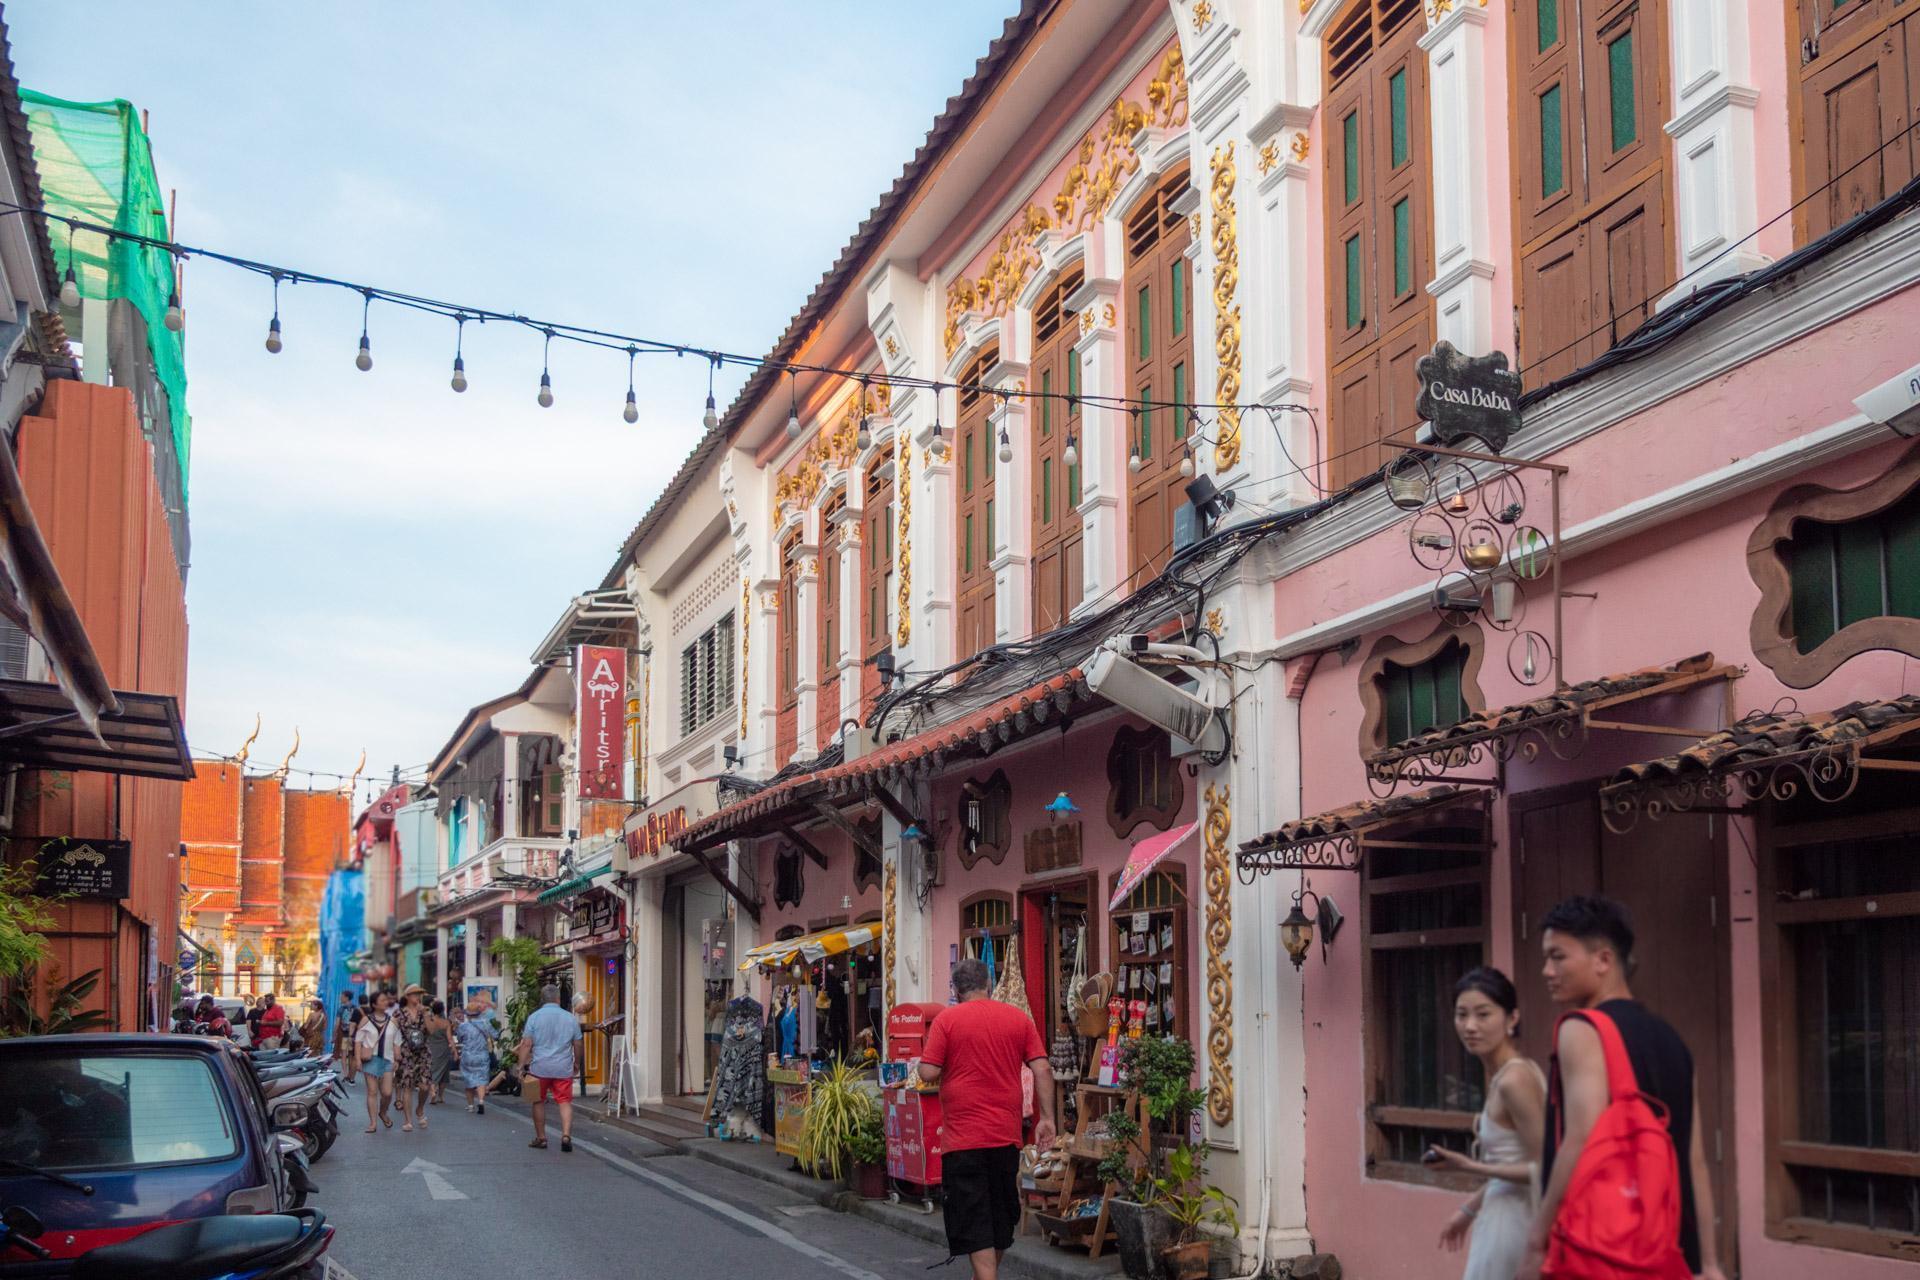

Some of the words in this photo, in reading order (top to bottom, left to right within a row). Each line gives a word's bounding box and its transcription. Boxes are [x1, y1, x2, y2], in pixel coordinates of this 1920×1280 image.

[1430, 381, 1470, 406] Casa
[1471, 387, 1512, 411] Baba
[891, 1014, 900, 1023] The
[901, 1013, 922, 1023] Postcard
